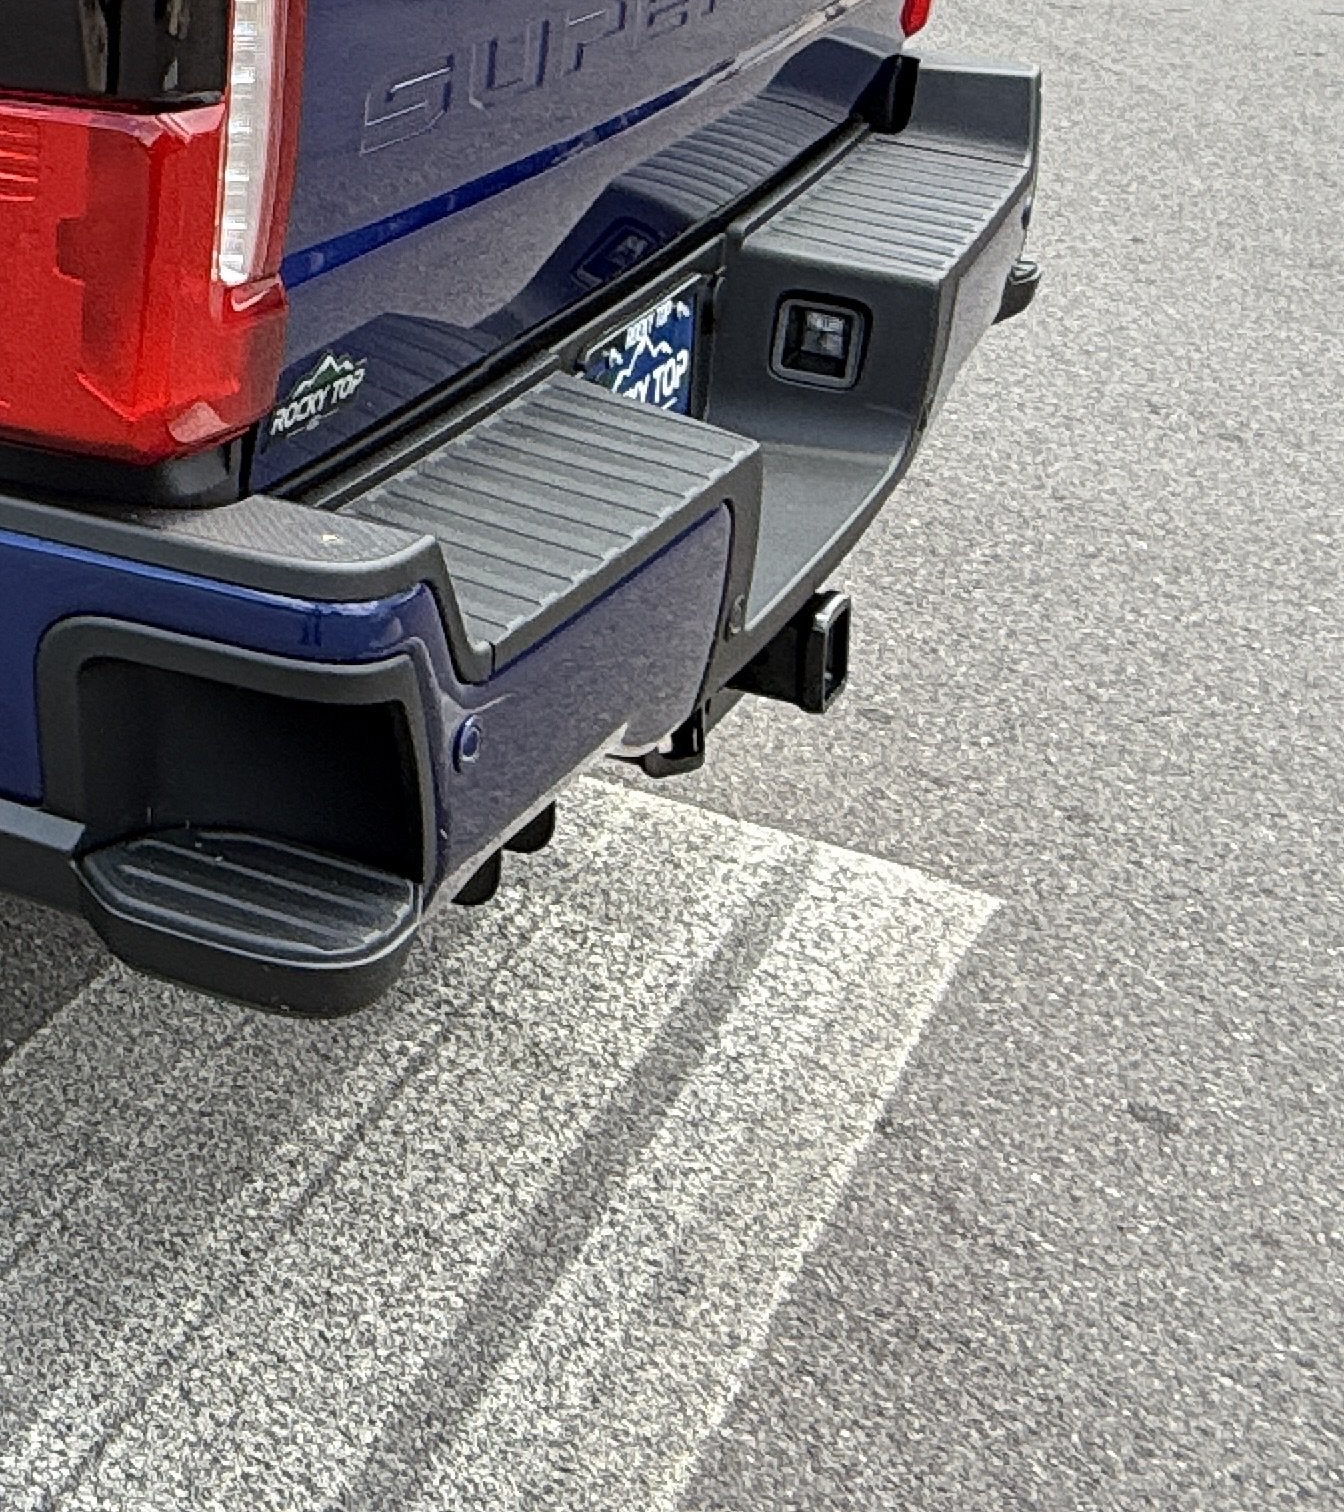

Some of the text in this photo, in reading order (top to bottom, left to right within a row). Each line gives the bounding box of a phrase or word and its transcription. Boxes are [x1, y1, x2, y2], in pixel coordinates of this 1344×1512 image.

[270, 367, 366, 436] ROCKY TOP
[652, 348, 690, 404] TOP
